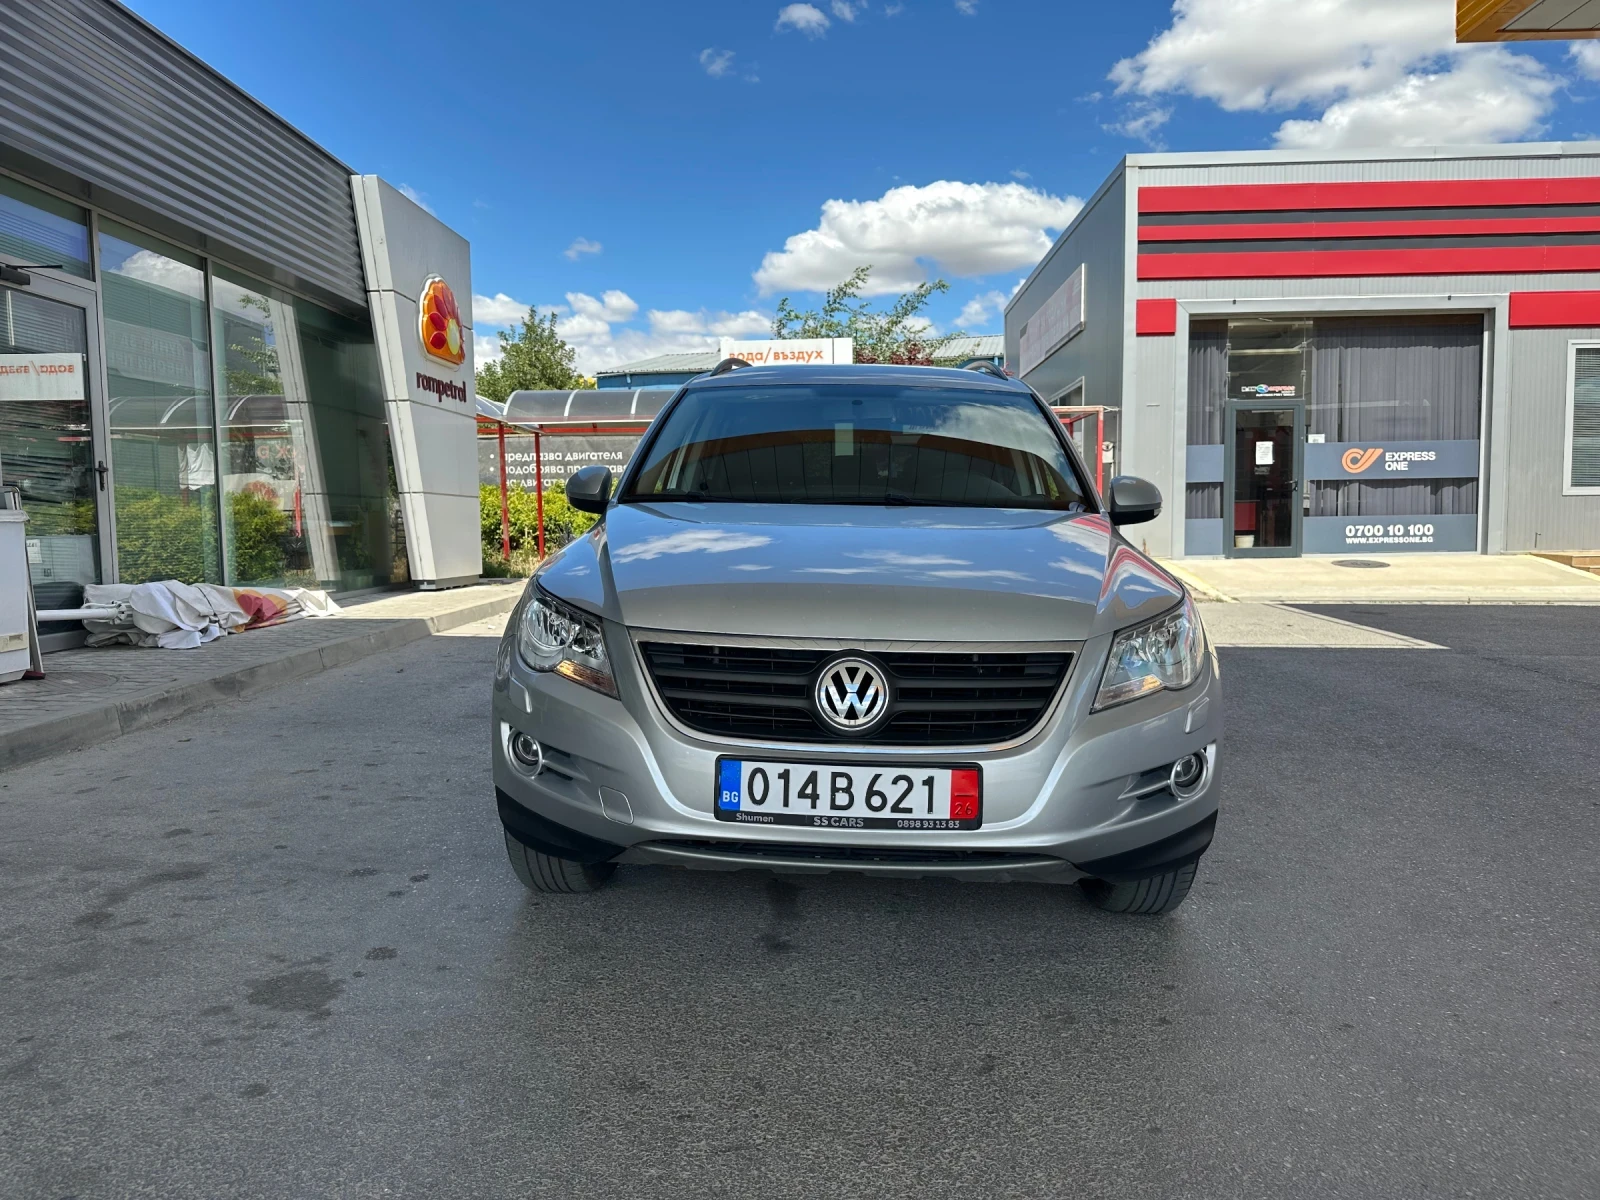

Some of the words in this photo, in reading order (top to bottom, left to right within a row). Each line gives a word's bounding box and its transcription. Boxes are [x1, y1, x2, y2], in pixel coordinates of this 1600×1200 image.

[416, 372, 466, 403] rompetrol
[565, 451, 623, 461] двигателя
[1385, 452, 1436, 461] EXPRESS
[1385, 461, 1408, 471] ONE
[1345, 525, 1383, 537] 0700
[1387, 525, 1404, 536] 10
[1408, 524, 1434, 536] 100
[722, 790, 739, 803] BG
[736, 812, 774, 823] Shumen
